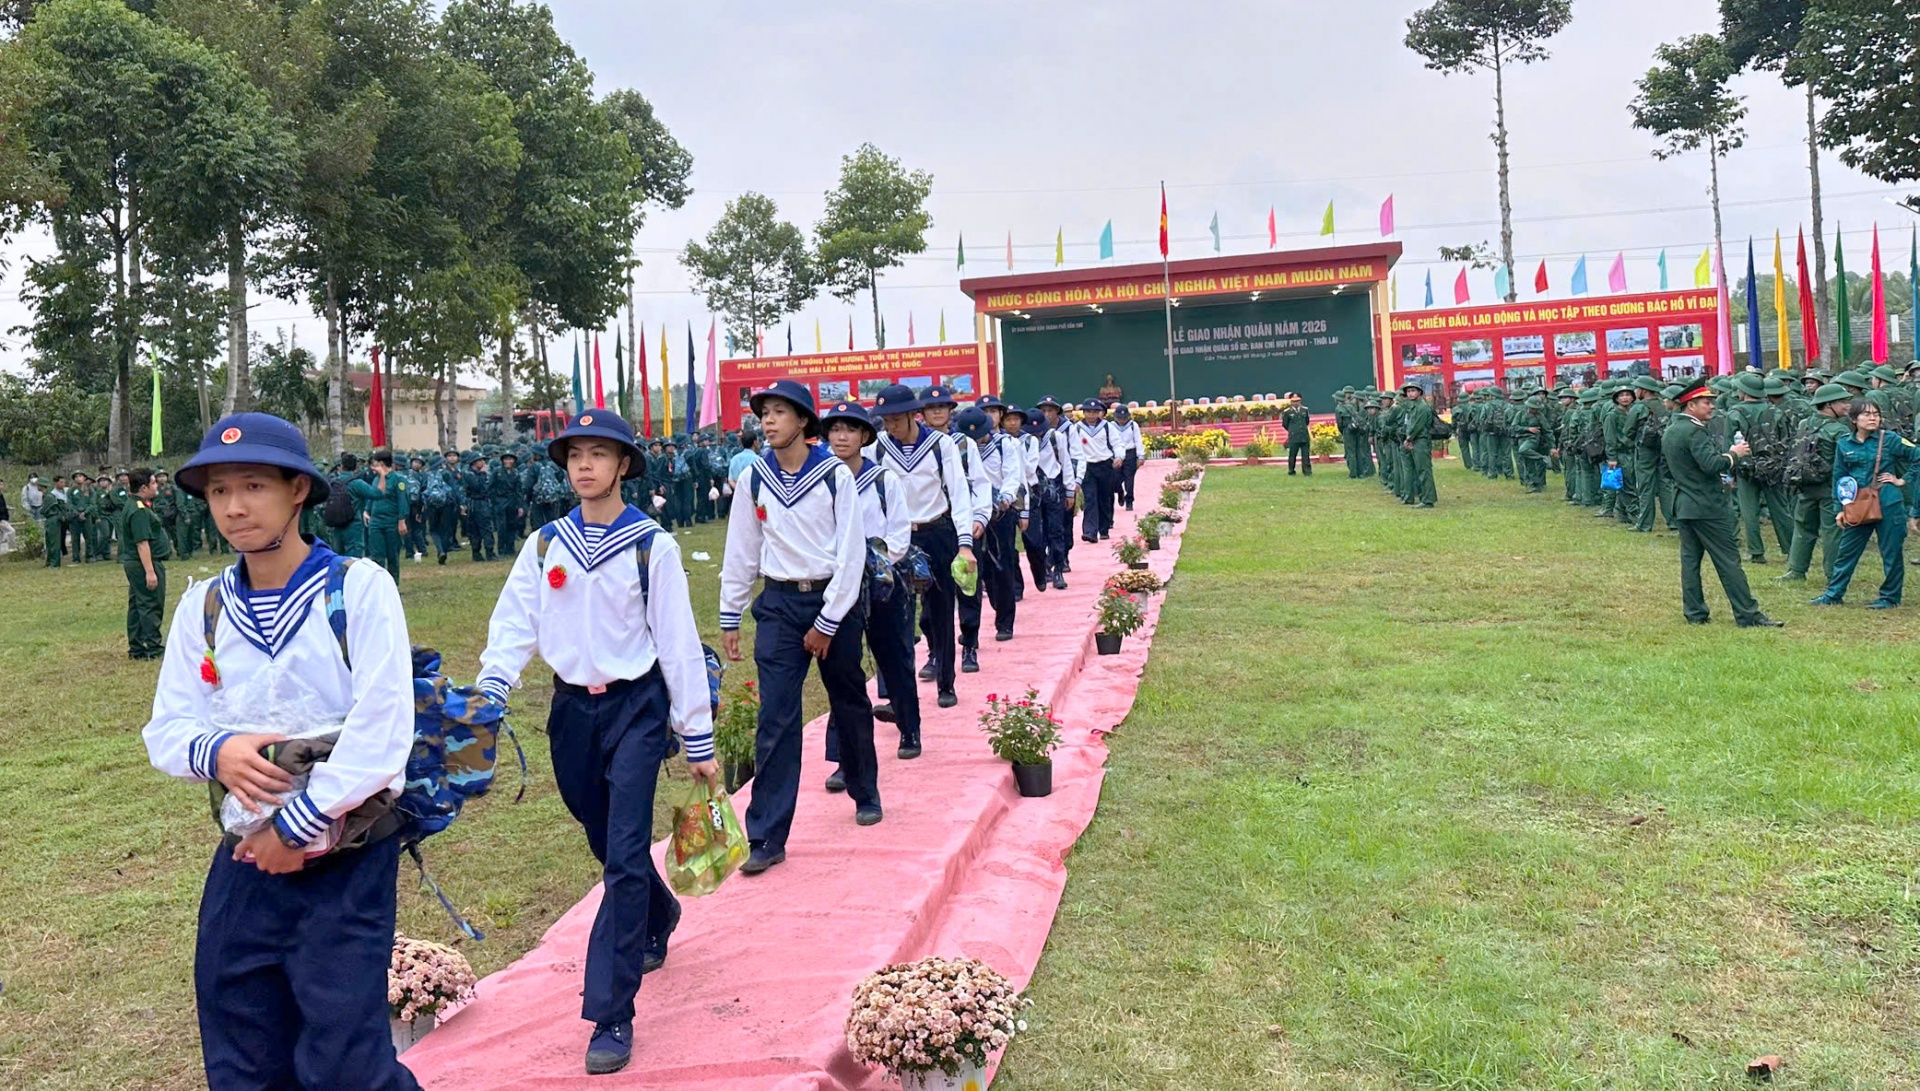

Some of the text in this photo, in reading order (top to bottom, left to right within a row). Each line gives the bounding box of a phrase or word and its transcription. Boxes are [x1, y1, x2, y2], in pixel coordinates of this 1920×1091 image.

[987, 291, 1023, 308] NƯỚC
[1026, 289, 1061, 307] CỘNG
[1065, 286, 1092, 302] HÒA
[1095, 284, 1113, 299] XÃ
[1117, 283, 1139, 298] HỘI
[1174, 277, 1217, 293] NGHĨA
[1220, 274, 1249, 291] VIỆT
[1254, 272, 1287, 287] NAM
[1291, 267, 1335, 284] MUÔN
[1338, 264, 1373, 279] NĂM
[1173, 319, 1327, 343] LỄ GIAO NHẬN QUÂN NĂM 2026
[1390, 295, 1718, 331] ỐNG, CHIẾN ĐẤU, LAO ĐỘNG VÀ HỌC TẬP THEO GƯƠNG BÁC HỒ VĨ ĐẠI
